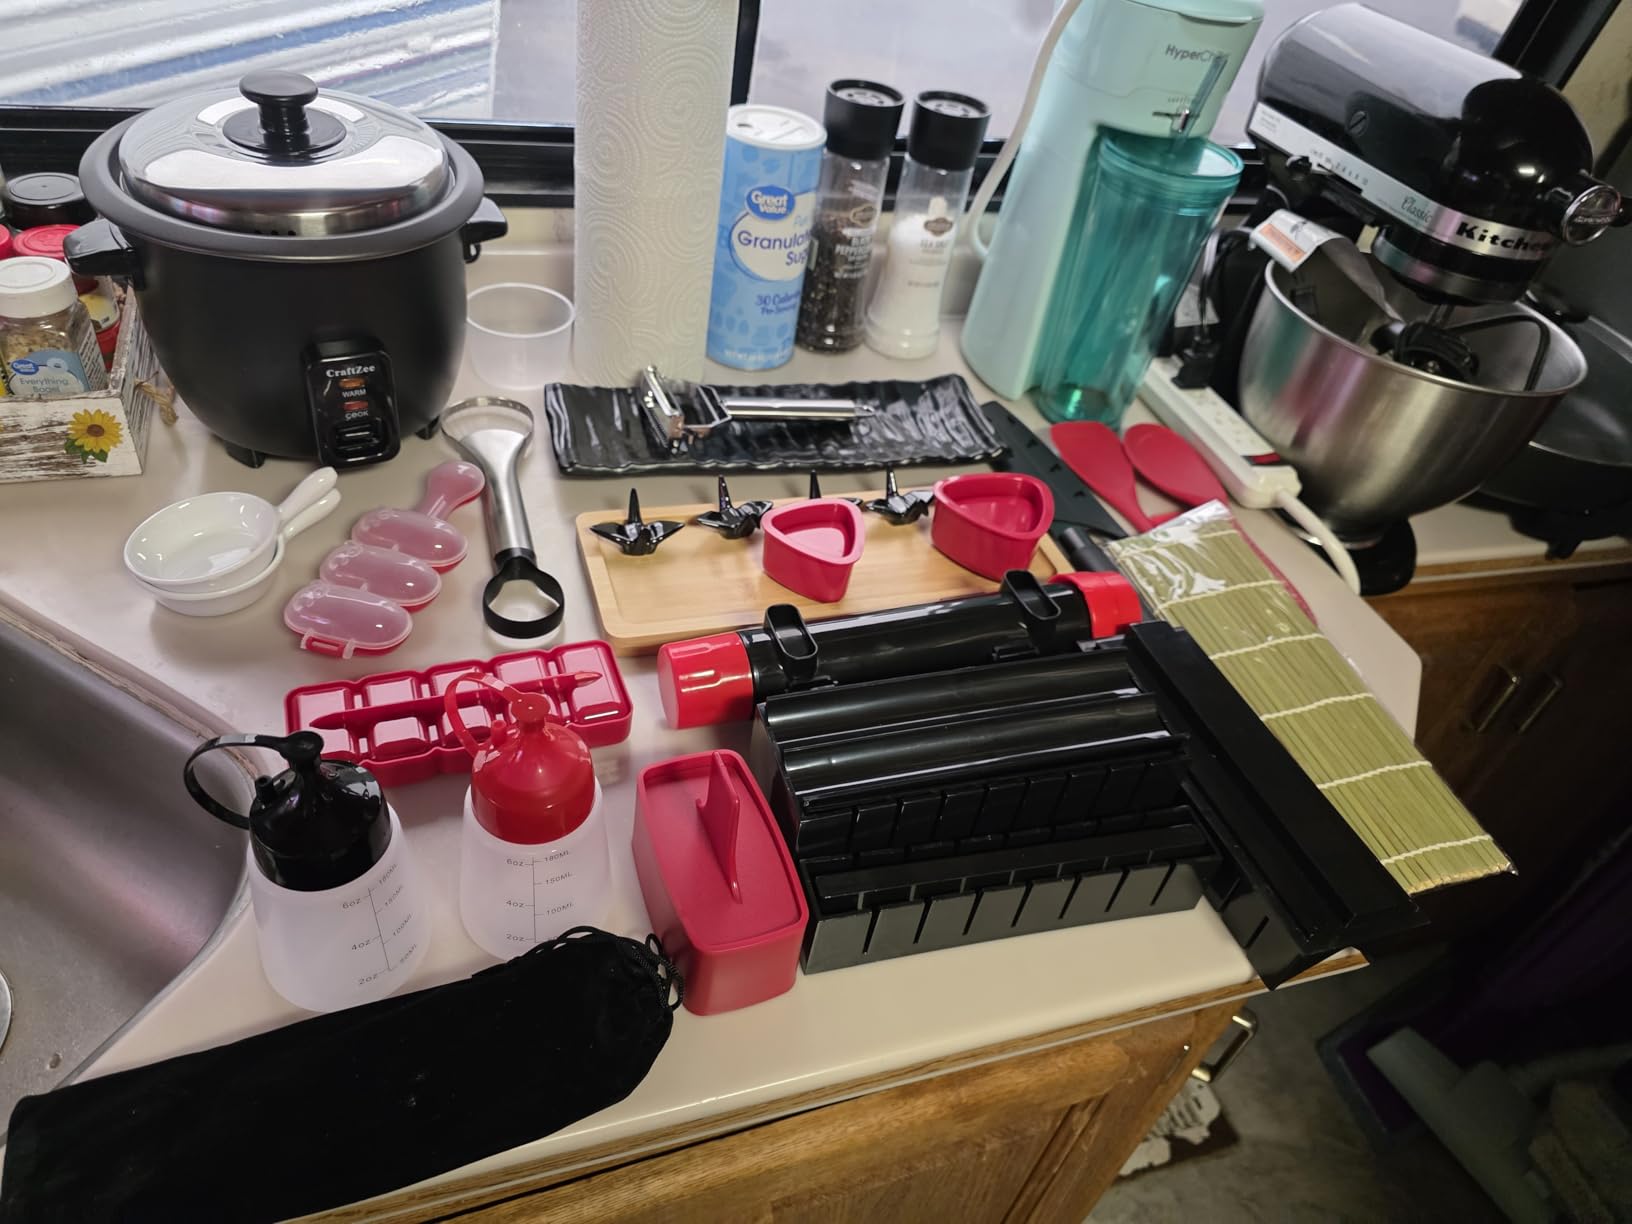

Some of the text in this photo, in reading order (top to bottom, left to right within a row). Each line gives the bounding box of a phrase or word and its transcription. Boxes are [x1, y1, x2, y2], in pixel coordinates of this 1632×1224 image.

[751, 190, 788, 207] Great
[1401, 196, 1433, 224] Classic
[325, 365, 376, 378] CraftZee
[20, 375, 69, 386] Everything
[342, 388, 367, 398] WARM
[345, 410, 369, 420] COOK
[545, 871, 573, 885] 150ML
